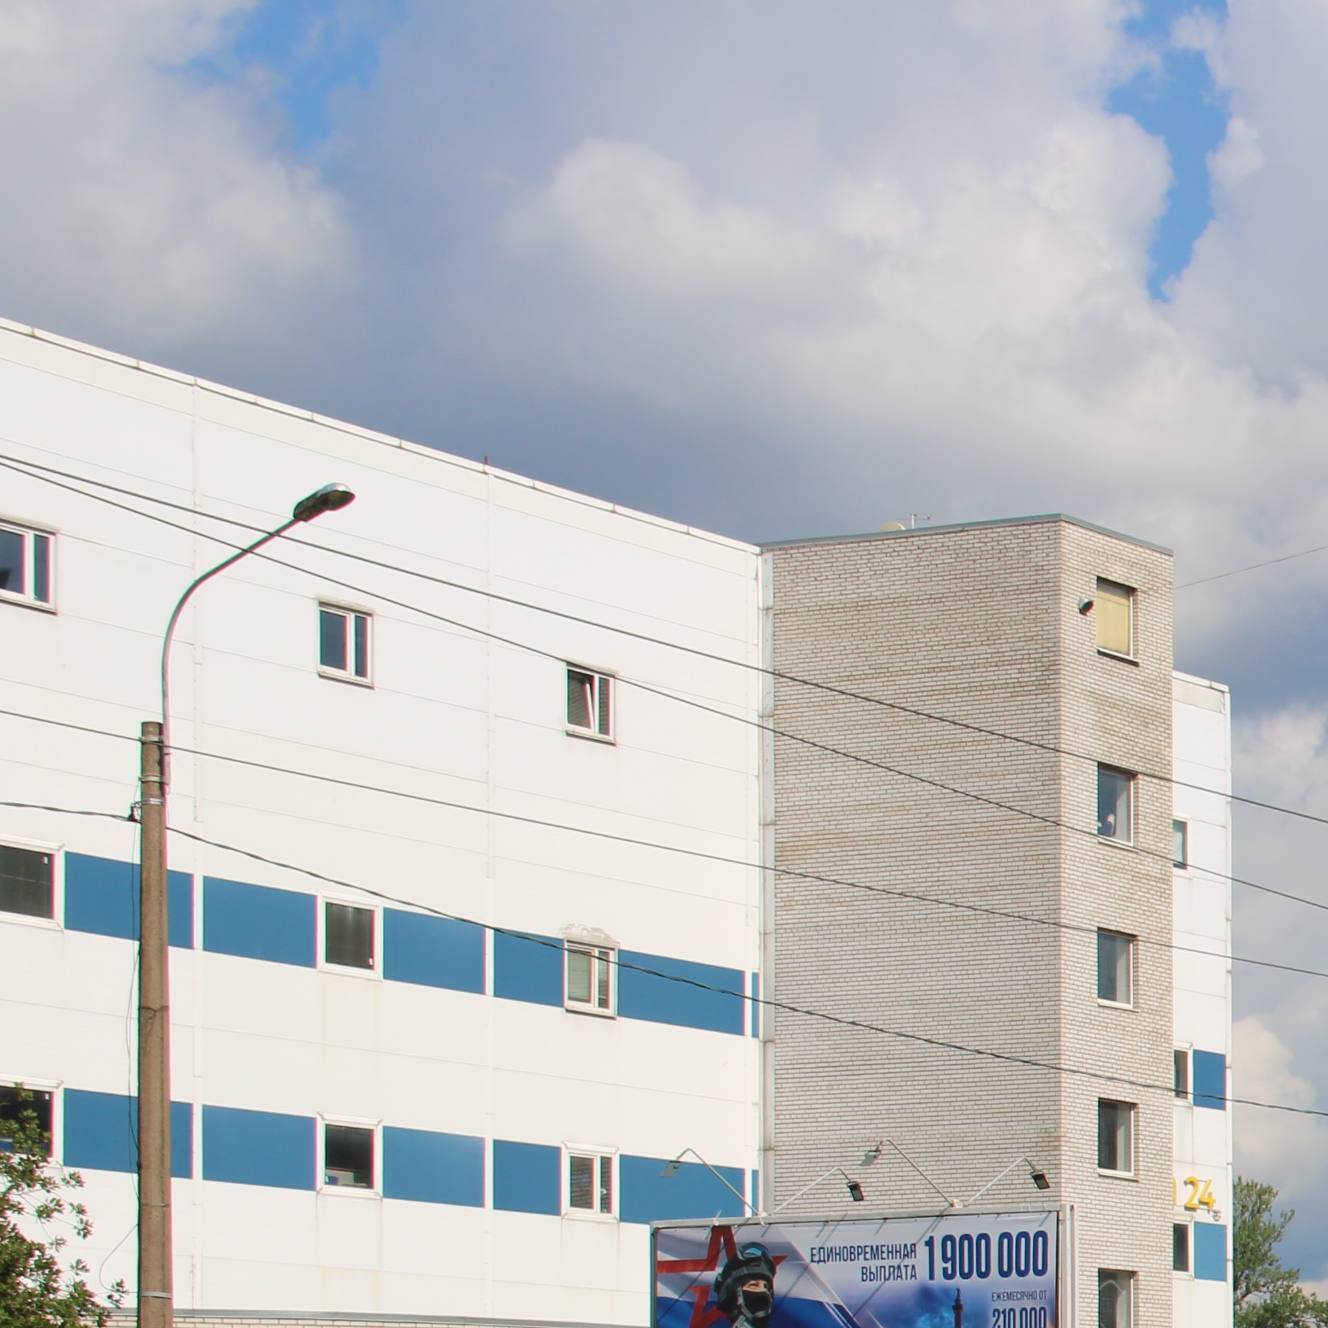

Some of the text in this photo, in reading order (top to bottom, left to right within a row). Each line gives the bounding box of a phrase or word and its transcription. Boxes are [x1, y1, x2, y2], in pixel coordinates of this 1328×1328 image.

[810, 1243, 917, 1264] ЕДИНОВРЕМЕННАЯ
[998, 1230, 1049, 1278] 000
[861, 1265, 917, 1282] ВЫПЛАТА
[991, 1289, 1048, 1302] ЕЖЕМЕСЯЧНО ОТ
